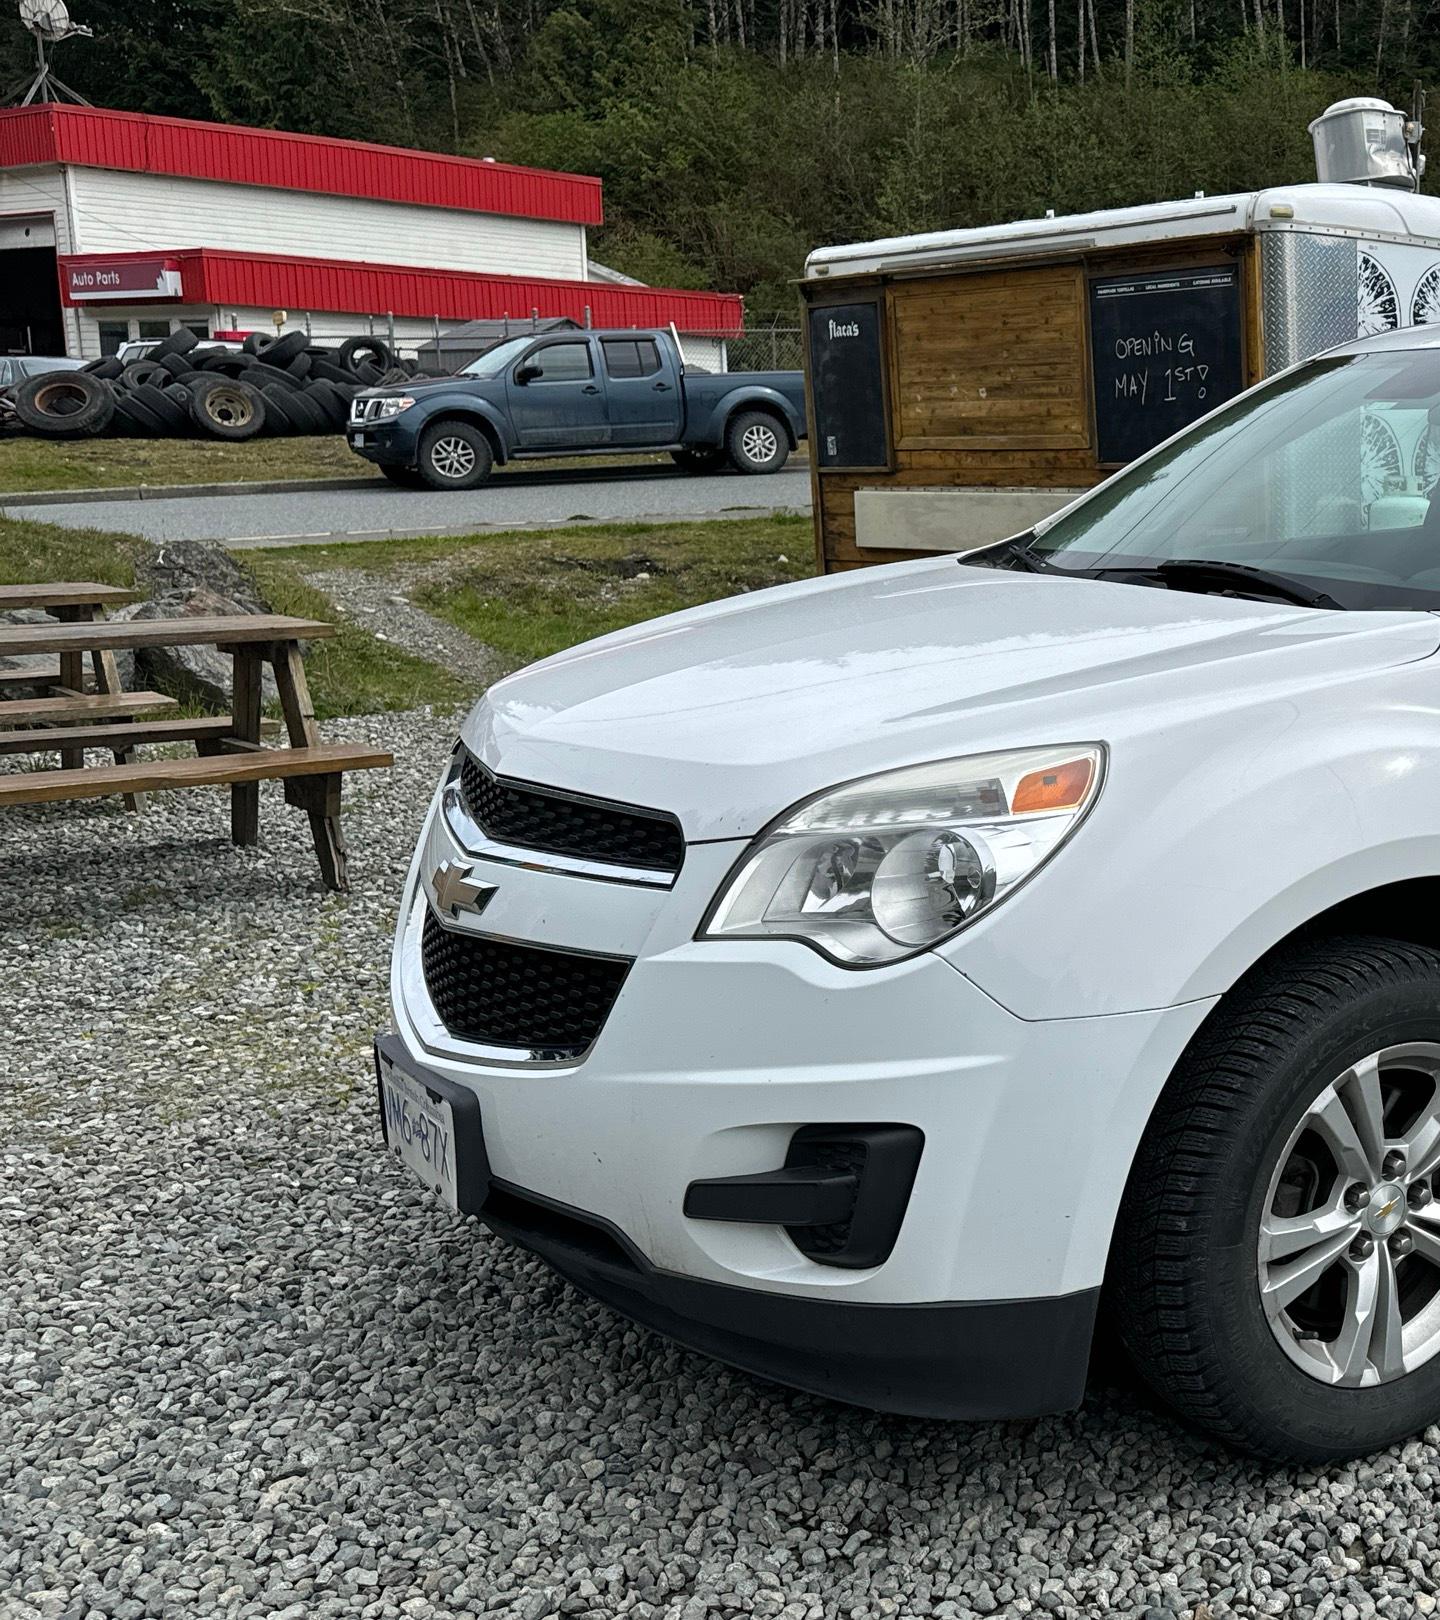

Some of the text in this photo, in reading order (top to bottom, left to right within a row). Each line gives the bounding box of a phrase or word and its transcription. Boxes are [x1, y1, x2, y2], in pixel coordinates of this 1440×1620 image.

[72, 270, 120, 286] Auto Parts
[1115, 367, 1148, 405] MAY
